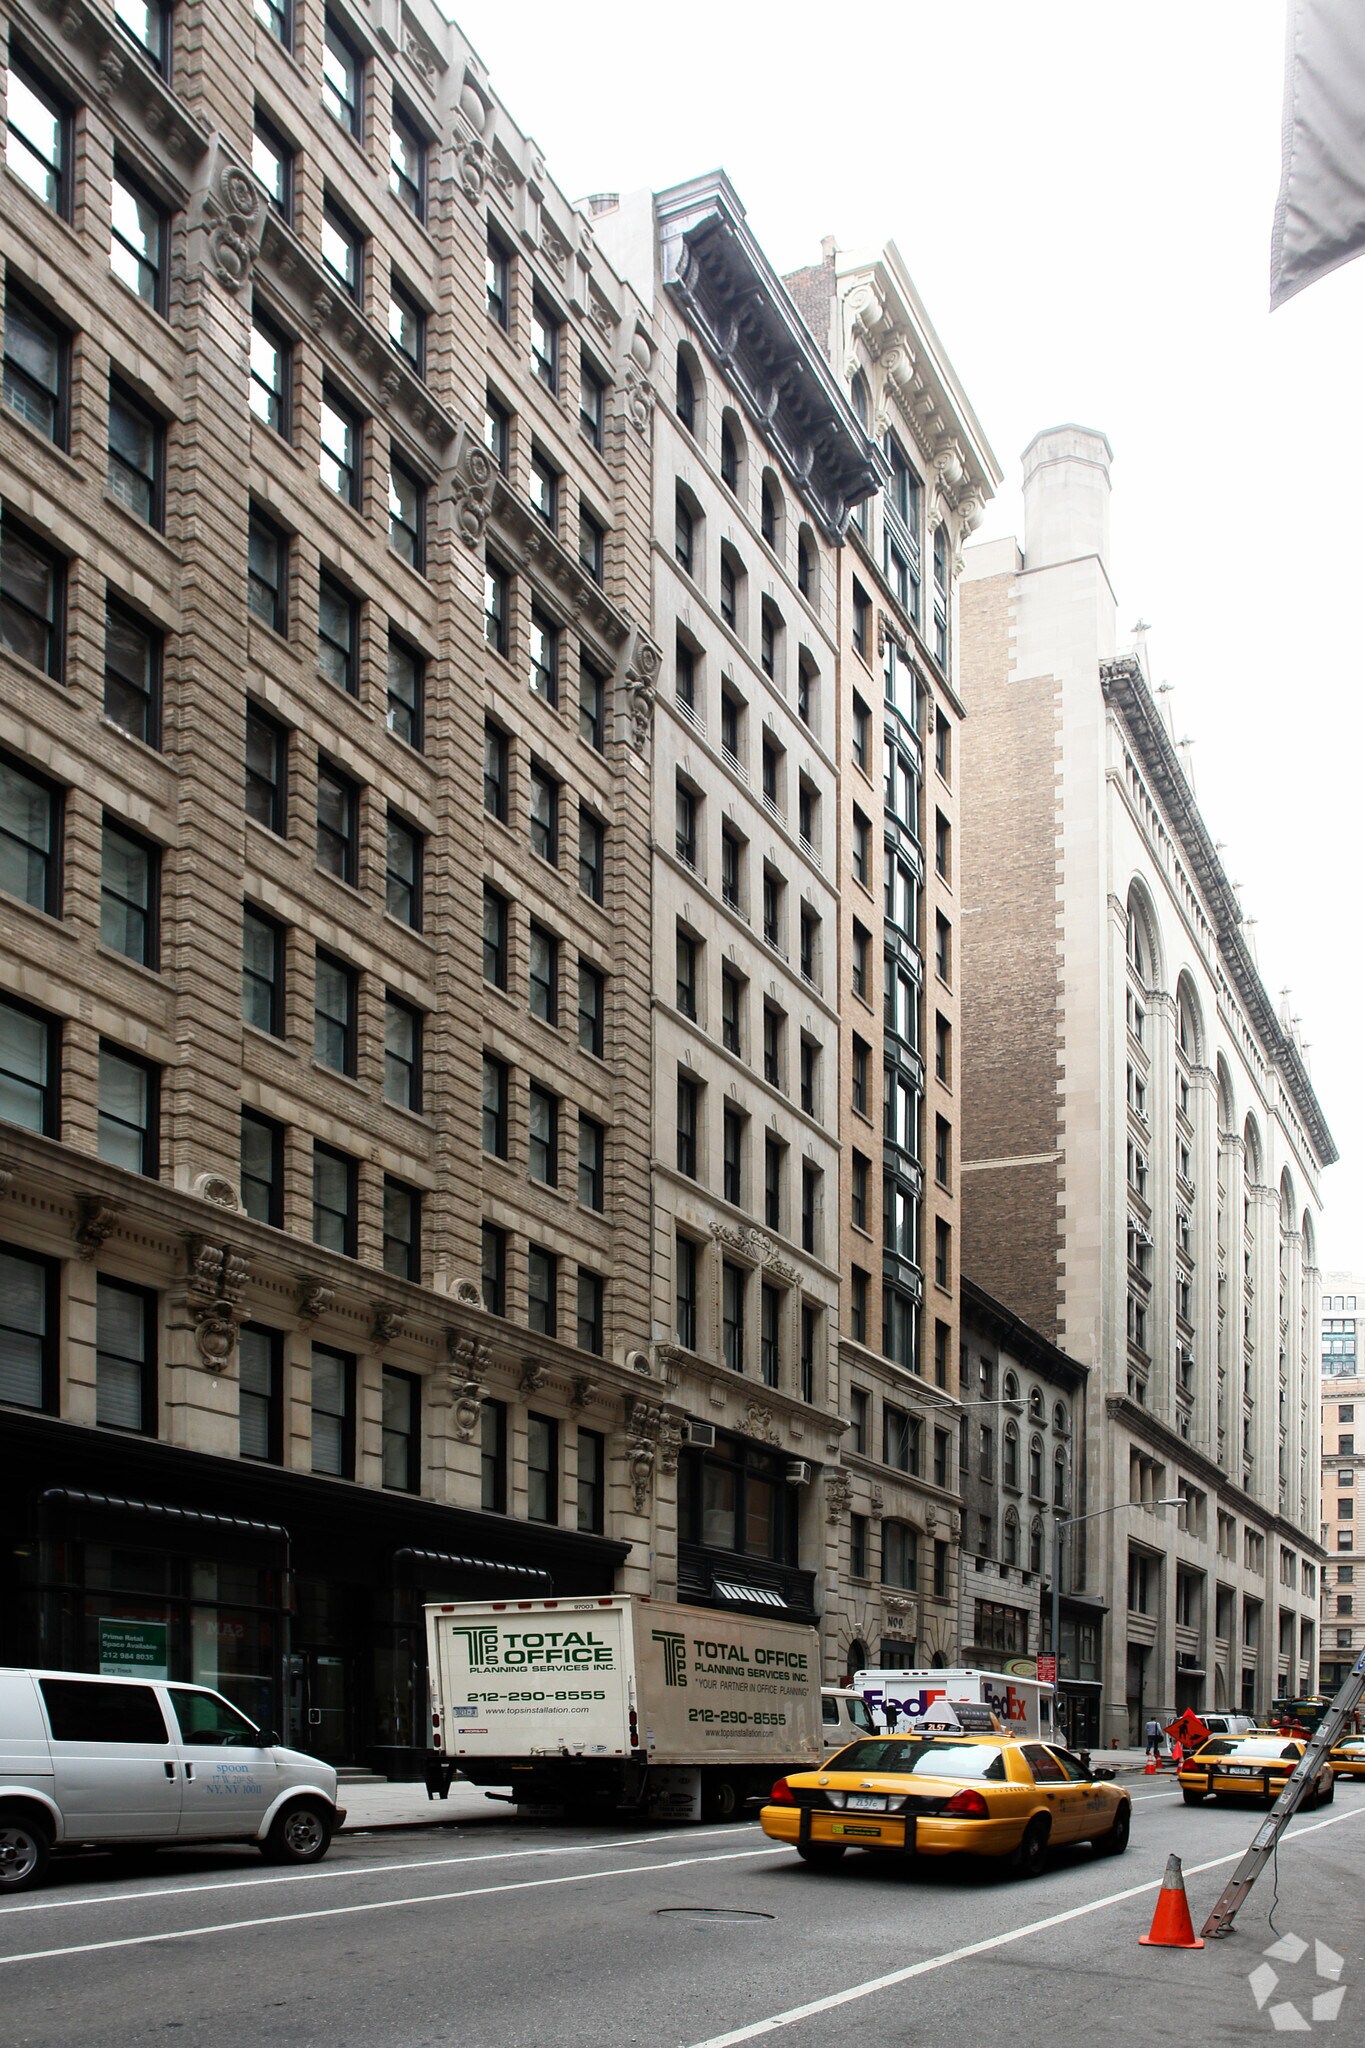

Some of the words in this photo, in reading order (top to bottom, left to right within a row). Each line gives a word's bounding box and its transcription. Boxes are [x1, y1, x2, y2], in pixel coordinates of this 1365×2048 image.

[102, 1633, 124, 1641] Prime
[124, 1634, 144, 1642] Retail
[503, 1631, 604, 1648] TOTAL
[102, 1641, 125, 1649] Space
[126, 1642, 157, 1650] Available
[102, 1651, 118, 1659] 212
[503, 1647, 613, 1665] OFFICE
[693, 1640, 750, 1663] TOTAL
[755, 1648, 808, 1669] OFFICE
[469, 1665, 528, 1674] PLANNING
[532, 1664, 590, 1673] SERVICES
[593, 1663, 617, 1671] INC.
[694, 1662, 745, 1677] PLANNING
[747, 1668, 790, 1681] SERVICES
[792, 1673, 809, 1683] INC.
[720, 1680, 749, 1692] PARTNER
[750, 1683, 756, 1692] IN
[757, 1683, 778, 1695] OFFICE
[467, 1690, 606, 1702] 212-290-8555
[485, 1705, 590, 1716] www.topsinstallation.com
[688, 1708, 786, 1726] 212-290-8555
[927, 1723, 946, 1731] 2L57
[705, 1727, 774, 1739] www.topsinstallation.com
[216, 1764, 249, 1774] spoon
[225, 1784, 240, 1794] NY
